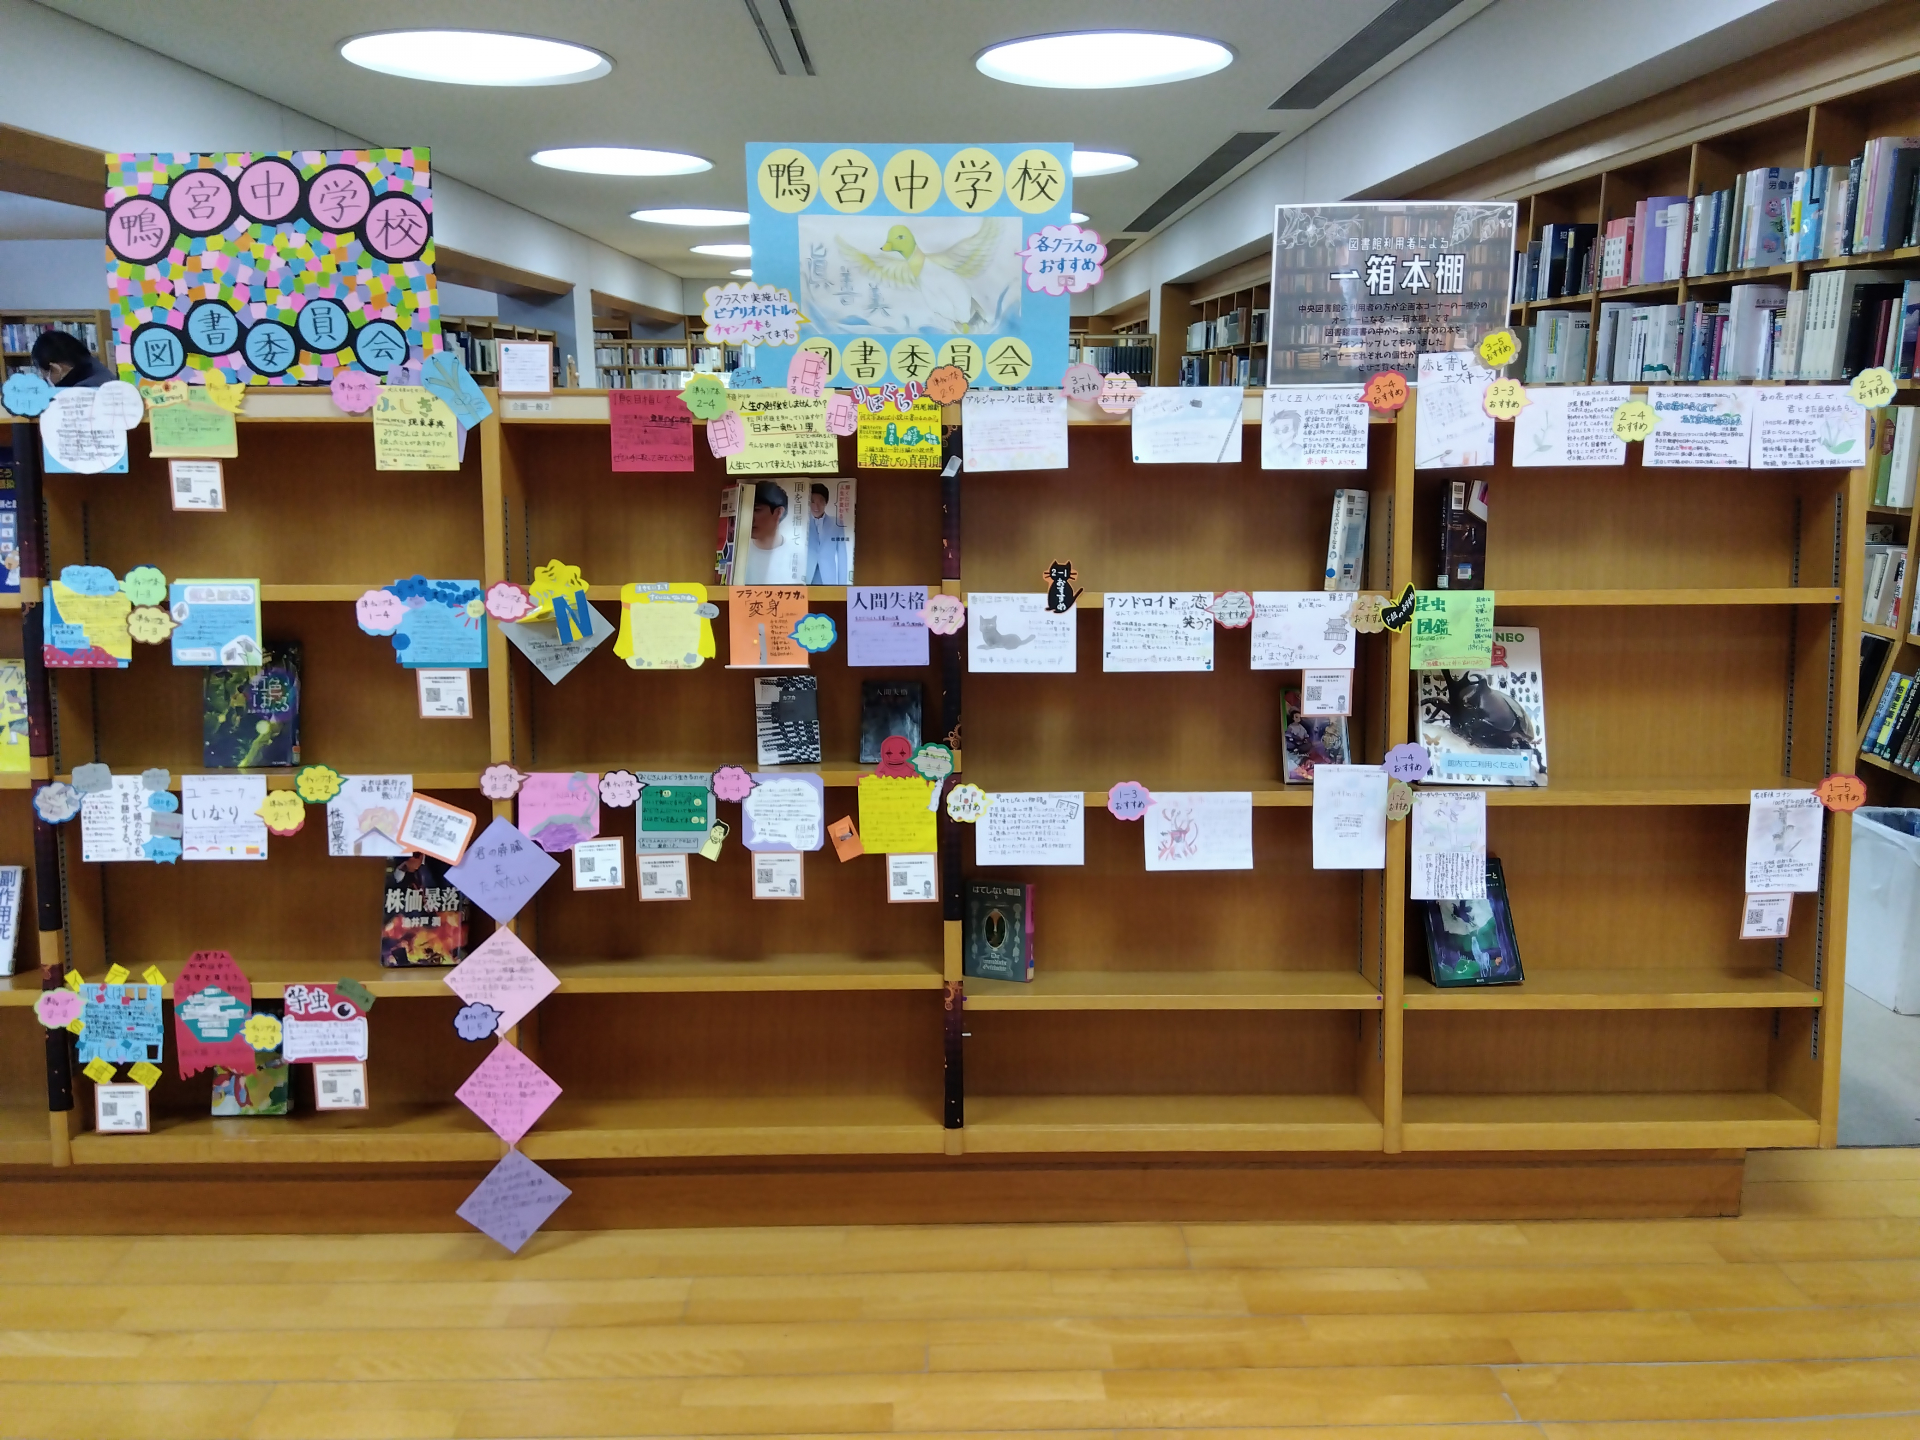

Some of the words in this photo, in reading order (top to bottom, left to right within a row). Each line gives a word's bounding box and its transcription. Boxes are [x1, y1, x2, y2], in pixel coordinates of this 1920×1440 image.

[767, 158, 1058, 209] 鴨宮中学校
[119, 169, 423, 250] 鴨宮中学校
[1035, 237, 1098, 254] 各クラスの
[1348, 237, 1449, 250] 図書館利用者による
[1038, 257, 1097, 273] おすすめ
[1330, 253, 1466, 295] 一箱本棚
[714, 291, 788, 304] クラスで実施した
[713, 304, 799, 319] ビブリオバトルの
[713, 319, 772, 334] チャンプ本も
[145, 306, 404, 368] 図書委員会
[1486, 345, 1512, 362] おすすめ
[1421, 357, 1469, 372] 赤と青と
[1072, 374, 1091, 384] 3-1
[1441, 371, 1496, 385] エスキース
[1859, 375, 1883, 388] 2-3
[790, 376, 799, 395] する
[1072, 384, 1099, 394] おすすめ
[1107, 380, 1127, 390] 3-2
[1375, 381, 1395, 393] 3-4
[1374, 388, 1404, 405] おすすめ
[1493, 387, 1514, 396] 3-3
[1859, 386, 1890, 399] おすすめ
[965, 392, 1055, 404] アルジャーノンに花束を
[1101, 394, 1136, 403] おすすめ
[1270, 393, 1360, 402] そして五人がいなくなる
[696, 399, 716, 410] 2-4
[913, 403, 940, 411] 西尾維新
[1489, 398, 1520, 409] おすすめ
[1620, 410, 1646, 420] 2-4
[826, 412, 835, 433] する
[1617, 422, 1648, 432] おすすめ
[792, 481, 806, 546] 頂を目指して
[1051, 568, 1068, 577] 2-1
[1056, 579, 1067, 611] おすすめ
[1329, 593, 1353, 602] 羅生門
[852, 591, 925, 611] 人間失格
[1222, 598, 1246, 608] 2-2
[1358, 601, 1380, 611] 2-5
[1415, 595, 1446, 612] 昆虫
[934, 615, 954, 624] 3-2
[1217, 610, 1248, 619] おすすめ
[1182, 615, 1212, 630] 笑う?
[1495, 632, 1524, 643] NEO
[1395, 754, 1414, 762] 1-4
[1394, 763, 1422, 773] おすすめ
[1447, 759, 1523, 770] 館内でご利用ください
[309, 787, 330, 795] 2-2
[1829, 782, 1851, 792] 1-5
[611, 789, 632, 799] 3-3
[1119, 789, 1138, 798] 1-3
[1391, 790, 1406, 801] 1-2
[1826, 793, 1860, 803] おすすめ
[952, 802, 981, 812] おすすめ
[1115, 800, 1146, 810] おすすめ
[1388, 802, 1409, 812] おすすめ
[191, 804, 240, 822] いなり
[479, 874, 530, 893] たべたい
[972, 886, 1021, 896] はてしない物語
[385, 888, 460, 913] 株価暴落
